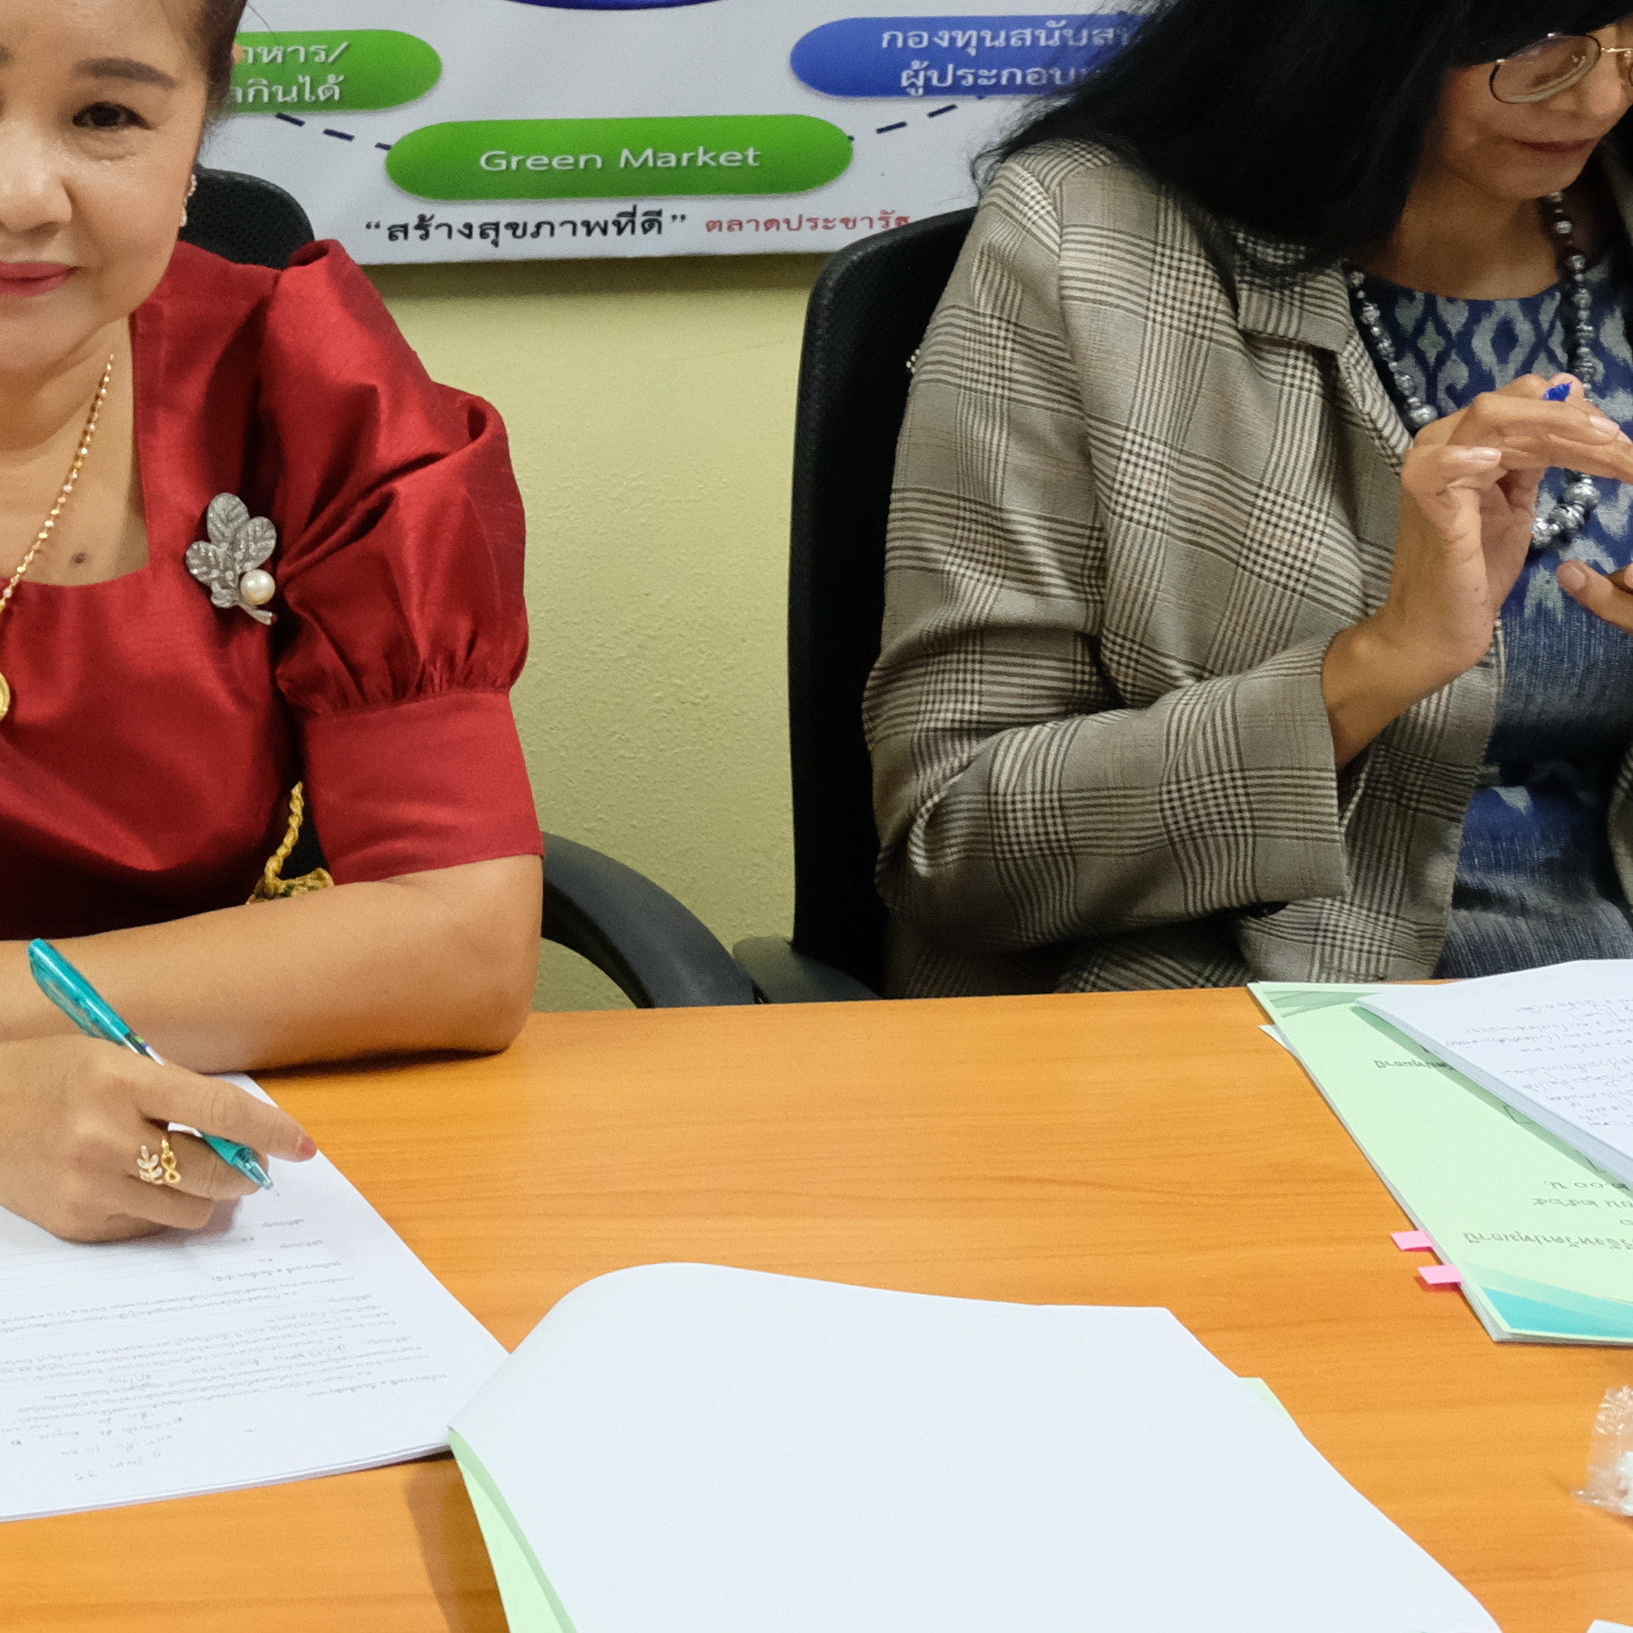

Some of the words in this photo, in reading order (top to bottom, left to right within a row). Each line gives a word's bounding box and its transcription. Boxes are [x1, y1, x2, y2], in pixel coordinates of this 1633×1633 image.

[479, 145, 607, 173] Green
[619, 145, 762, 172] Market
[365, 204, 687, 249] “สร้างสุขภาพที่ดี”
